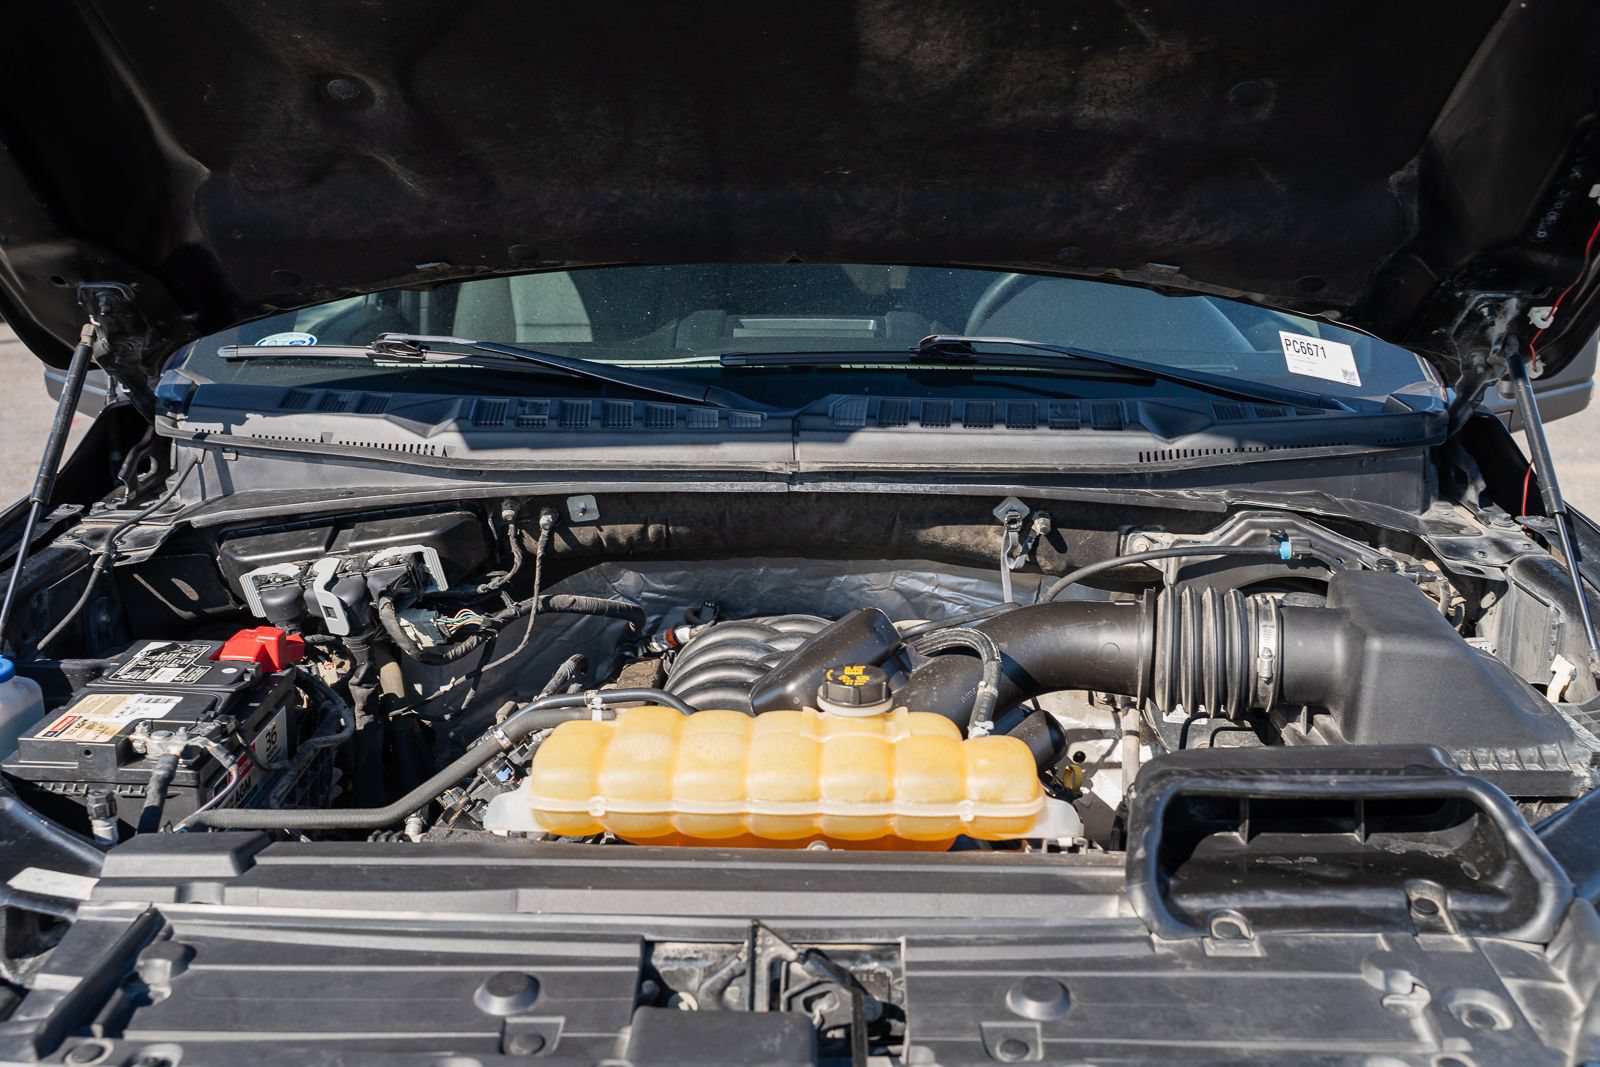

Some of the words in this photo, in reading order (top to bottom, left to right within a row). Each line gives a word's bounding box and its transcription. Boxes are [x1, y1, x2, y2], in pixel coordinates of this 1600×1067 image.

[1284, 338, 1327, 359] PC6671
[265, 725, 278, 752] 36
[235, 776, 252, 803] AGM
